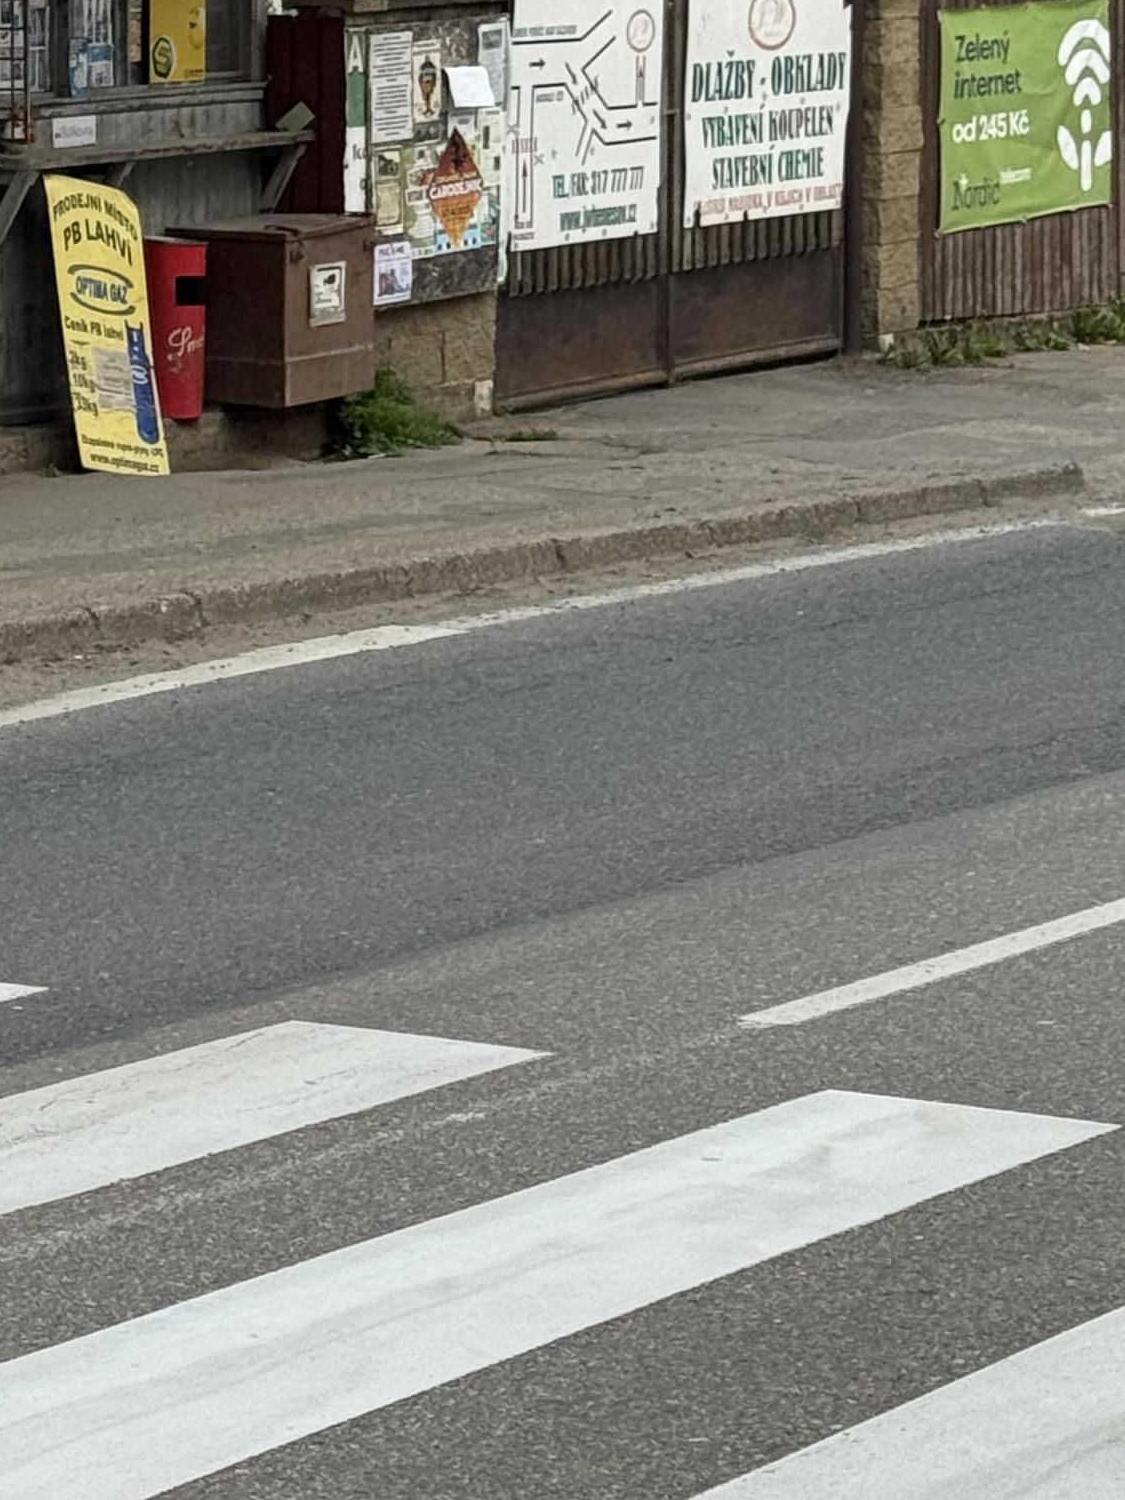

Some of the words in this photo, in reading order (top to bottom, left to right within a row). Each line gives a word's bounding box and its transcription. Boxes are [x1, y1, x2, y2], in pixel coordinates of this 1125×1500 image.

[954, 30, 1011, 65] Zelený
[691, 50, 756, 103] DLAŽBY
[770, 52, 847, 97] OBKLADY
[953, 68, 1022, 100] internet
[701, 103, 766, 149] VYBAVENÍ
[768, 104, 834, 143] KOUPELEN
[952, 114, 977, 143] od
[978, 112, 1008, 141] 245
[1009, 108, 1031, 137] Kč
[712, 144, 775, 190] STAVEBNÍ
[777, 146, 824, 182] CHEMIE
[951, 176, 1001, 211] Nordic
[63, 220, 82, 252] PB
[75, 276, 109, 301] OPTIMA
[90, 321, 102, 336] PB
